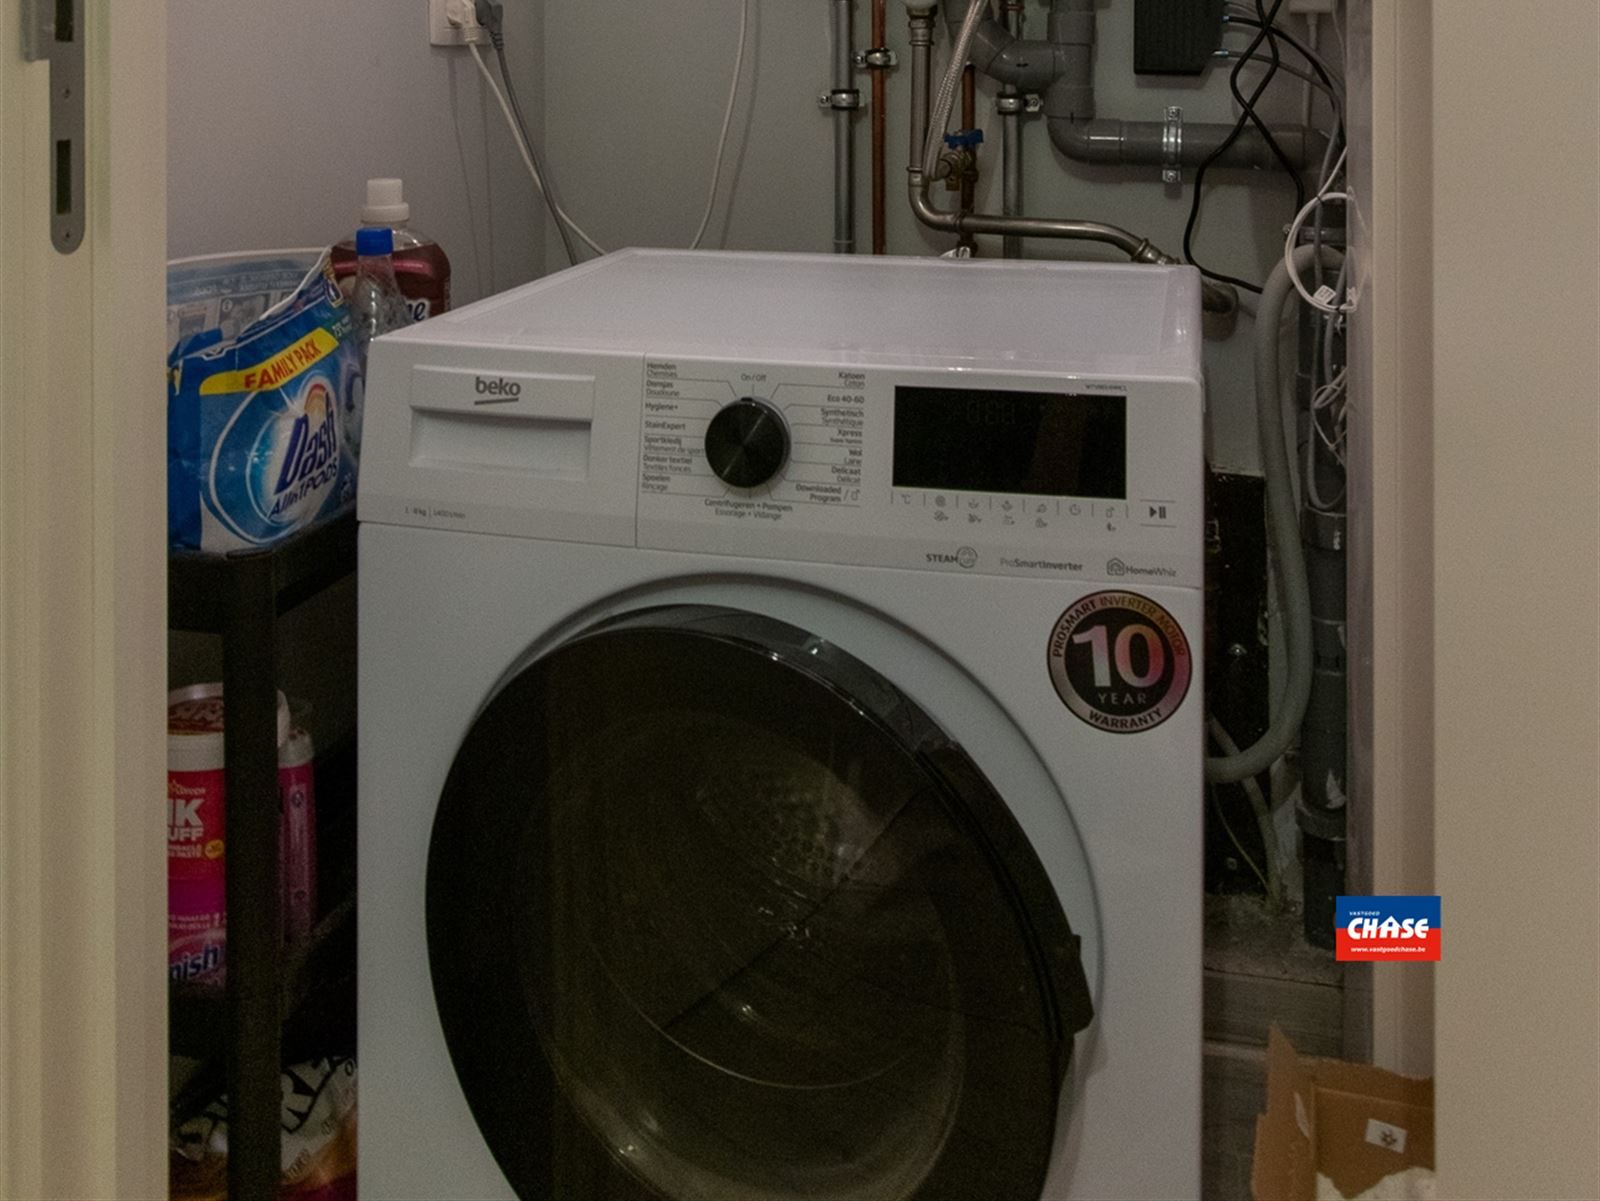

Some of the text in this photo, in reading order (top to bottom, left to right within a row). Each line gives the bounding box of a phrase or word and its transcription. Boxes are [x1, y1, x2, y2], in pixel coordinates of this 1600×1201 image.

[244, 339, 321, 390] FAMILY PACK
[838, 371, 866, 380] Katoen
[475, 376, 521, 396] beko
[827, 394, 840, 402] Eco
[644, 420, 686, 431] StainExpert
[273, 392, 337, 495] Dash
[831, 465, 862, 476] Delicaat
[926, 553, 958, 563] STEAM
[1000, 558, 1083, 572] ProSmartInverter
[1126, 565, 1177, 577] HomeWhiz
[1052, 595, 1185, 657] PROSMART INVERTER MOTOR
[1071, 623, 1165, 689] 10
[1097, 693, 1147, 705] YEAR
[1089, 707, 1162, 729] WARRANTY
